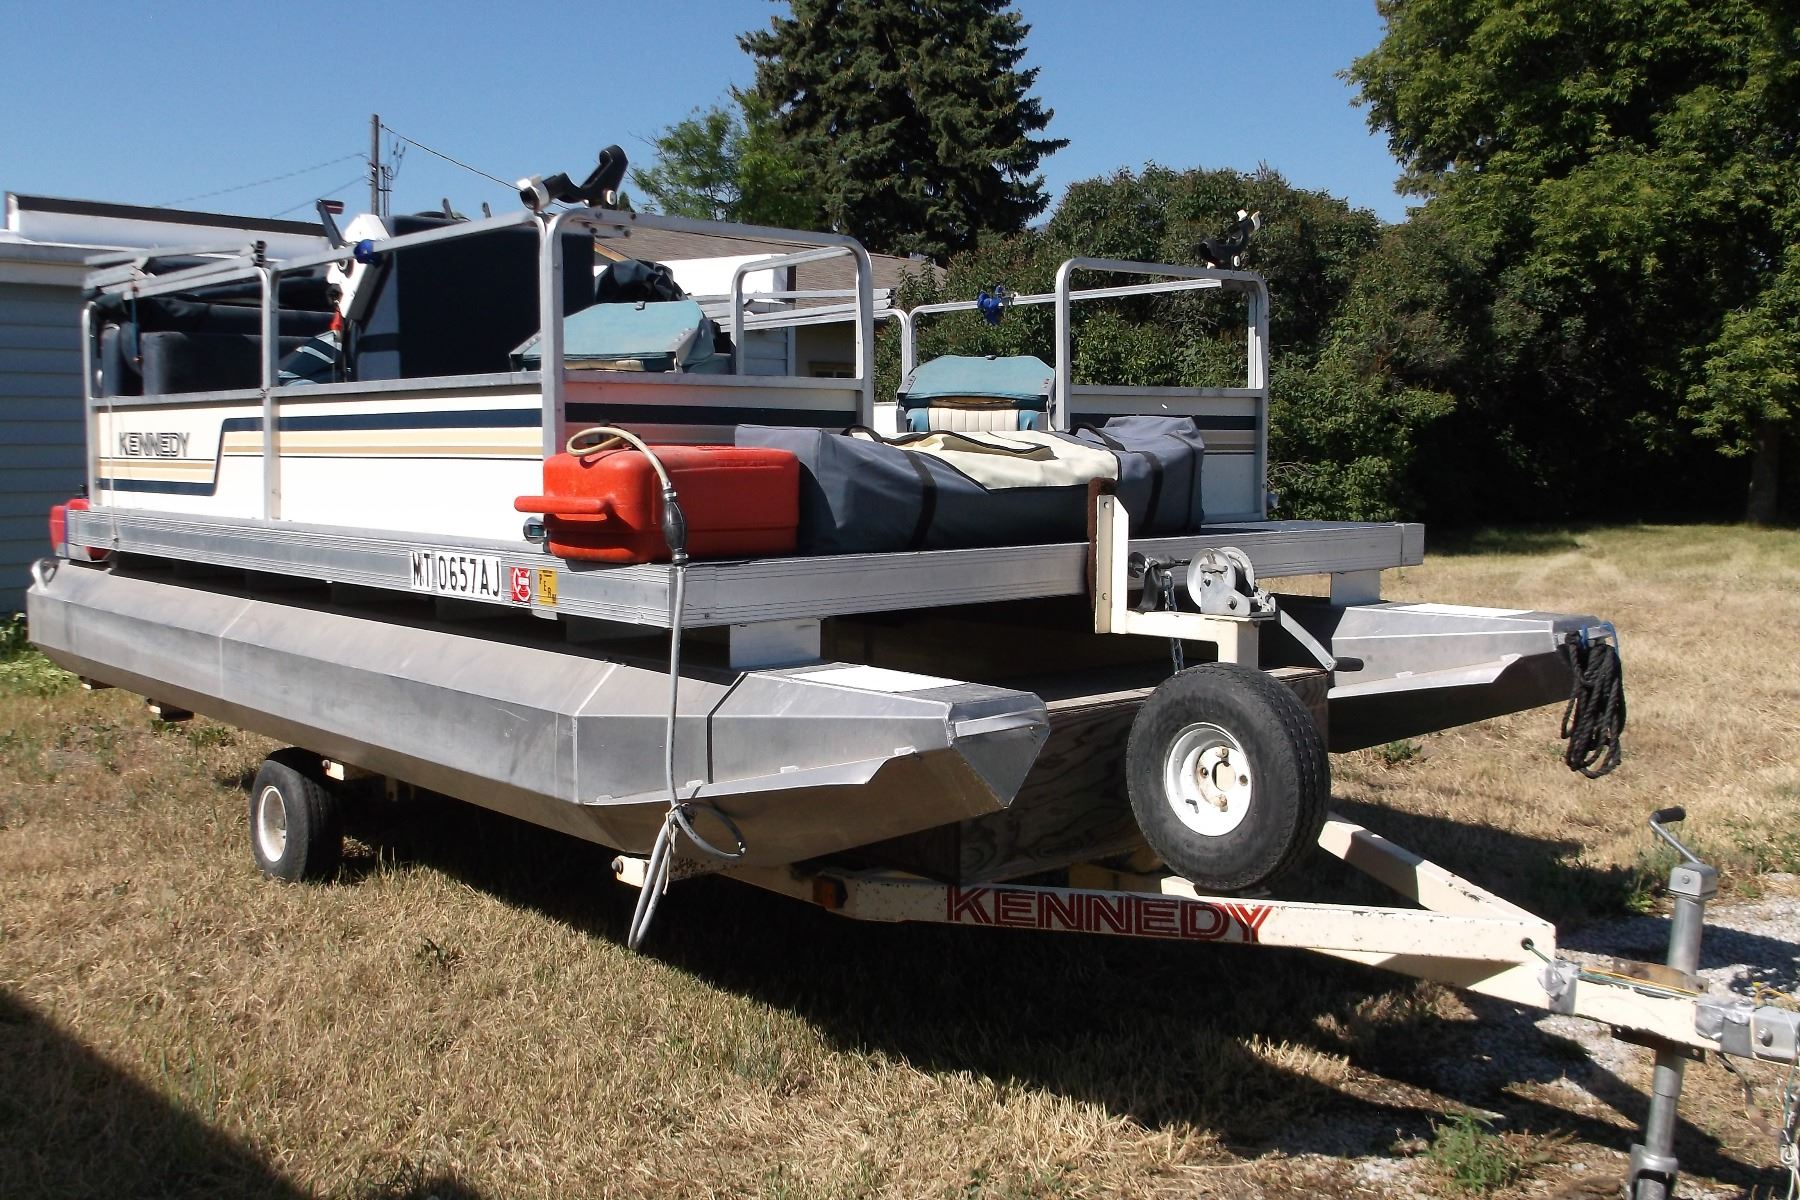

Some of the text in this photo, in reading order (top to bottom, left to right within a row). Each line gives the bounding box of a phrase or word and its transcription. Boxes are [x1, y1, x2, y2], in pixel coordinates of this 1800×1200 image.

[118, 432, 191, 457] KENNEDY
[412, 552, 431, 587] MT
[438, 556, 500, 597] 0657AJ
[946, 885, 1272, 944] KENNEDY
